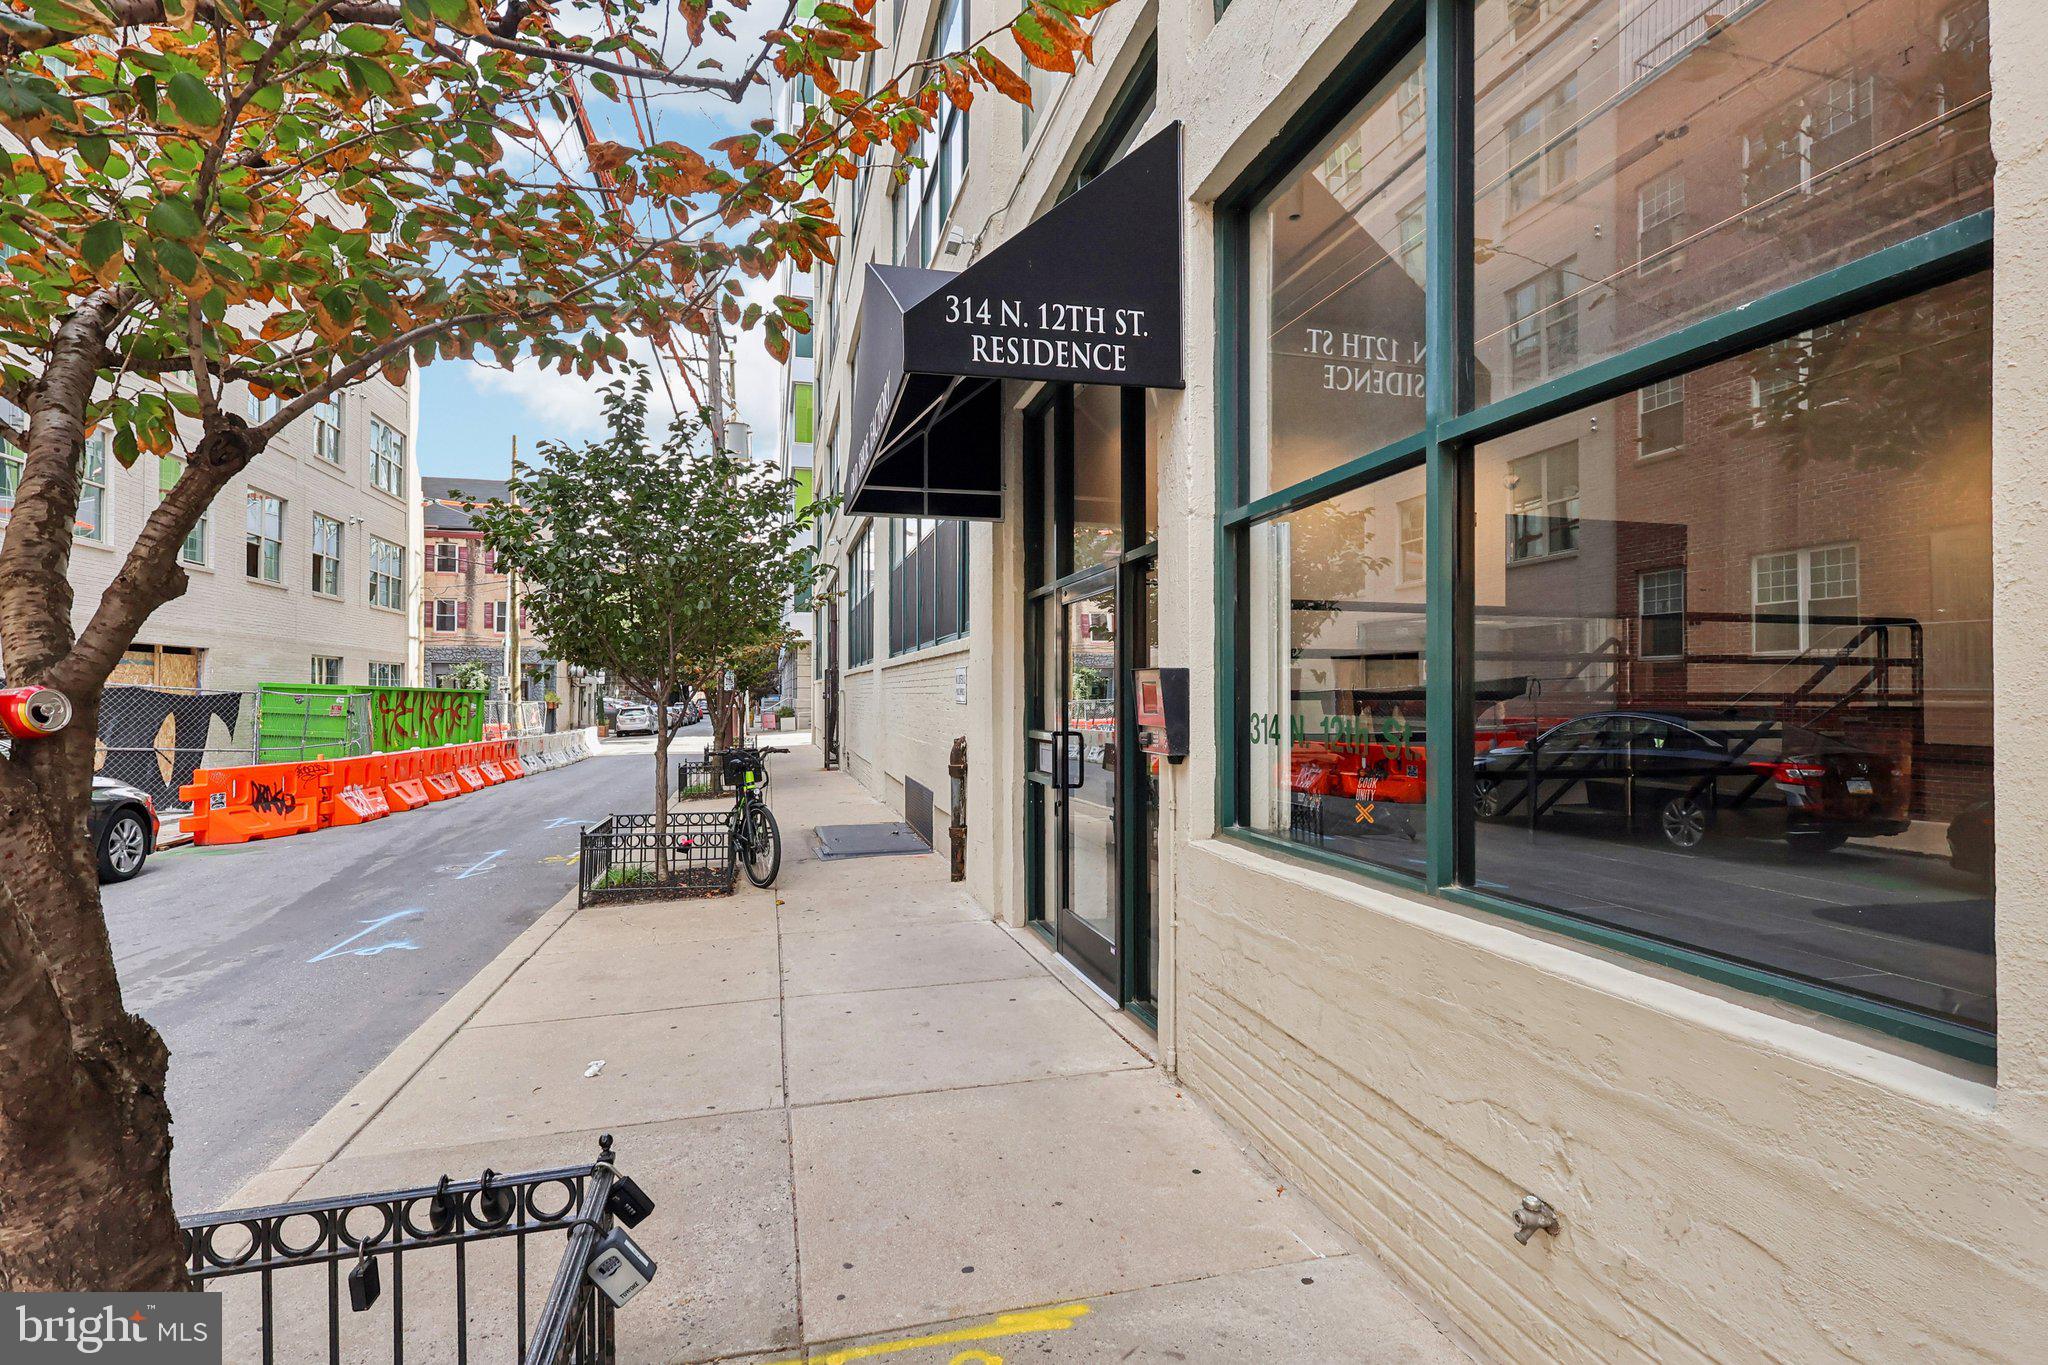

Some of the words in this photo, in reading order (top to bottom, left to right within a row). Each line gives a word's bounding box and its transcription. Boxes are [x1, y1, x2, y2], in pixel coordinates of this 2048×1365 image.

[945, 295, 991, 325] 314
[1000, 299, 1029, 328] N.
[1038, 302, 1106, 334] 12TH
[1115, 308, 1149, 337] ST.
[971, 334, 1127, 371] RESIDENCE
[1250, 712, 1281, 746] 314
[1290, 714, 1310, 749] N.
[1320, 715, 1369, 756] 12th
[1381, 718, 1422, 762] St.
[1355, 788, 1376, 801] UNITY
[1357, 776, 1379, 789] COOK
